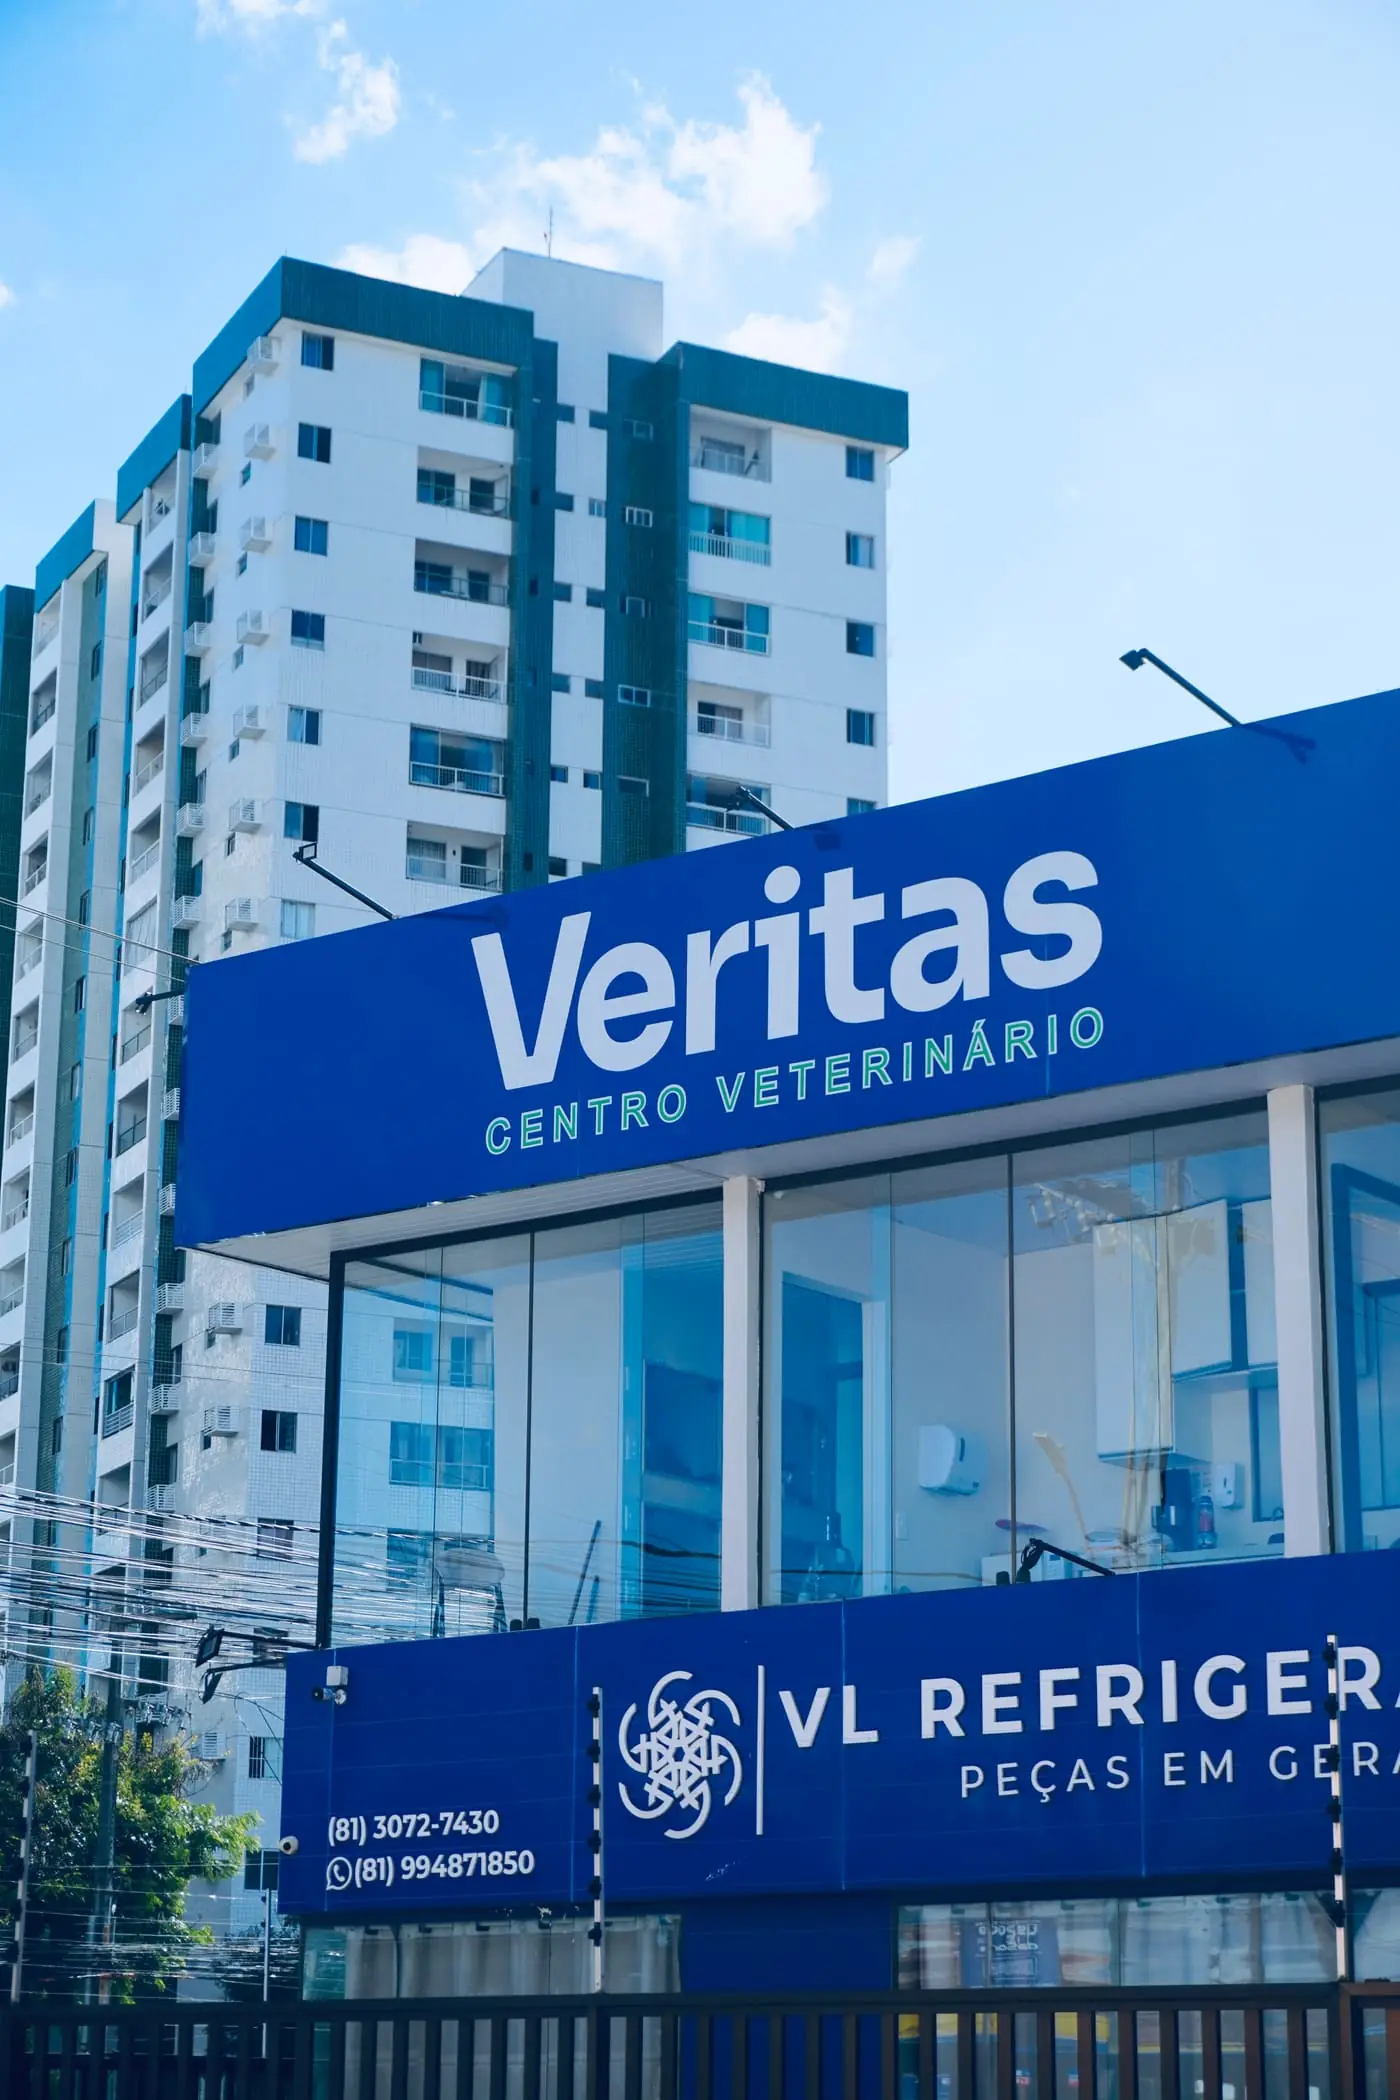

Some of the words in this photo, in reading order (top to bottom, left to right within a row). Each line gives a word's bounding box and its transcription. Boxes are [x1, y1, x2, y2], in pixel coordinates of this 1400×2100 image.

[470, 851, 1103, 1091] Veritas
[485, 1084, 688, 1155] CENTRO
[715, 1006, 1104, 1113] VETERINÁRIO
[778, 1684, 879, 1748] VL
[921, 1645, 1400, 1739] REFRIGER
[961, 1755, 1130, 1803] PEÇAS
[1163, 1750, 1234, 1786] EM
[1269, 1741, 1400, 1780] GER
[328, 1815, 366, 1847] (81)
[373, 1809, 499, 1839] 3072-7430
[354, 1856, 394, 1888] (81)
[401, 1849, 535, 1880] 994871850
